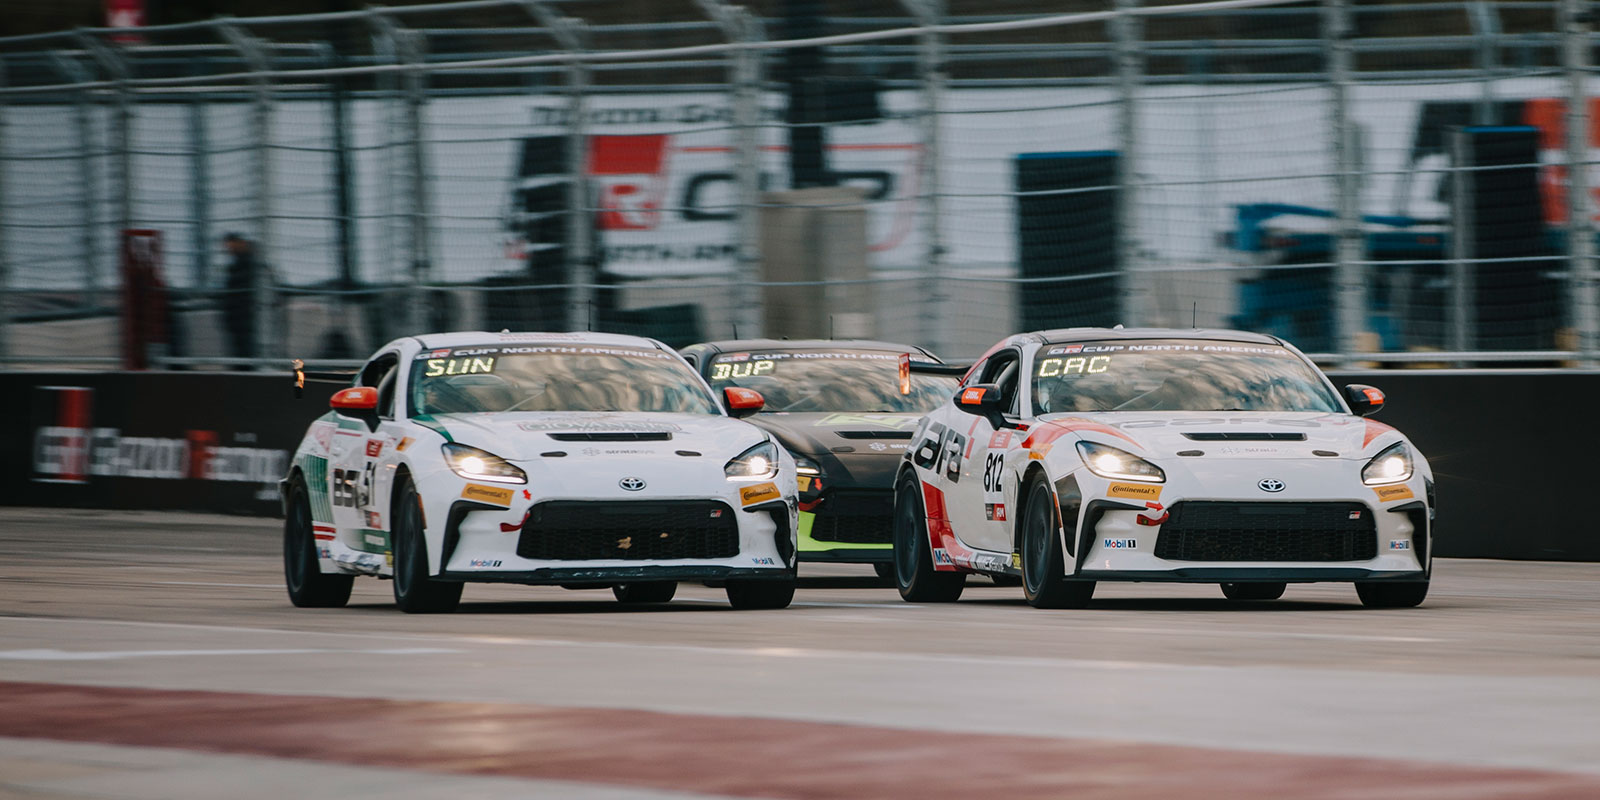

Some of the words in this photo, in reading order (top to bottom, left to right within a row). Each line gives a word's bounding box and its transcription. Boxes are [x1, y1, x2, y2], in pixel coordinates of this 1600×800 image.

[415, 349, 451, 360] GR
[454, 348, 498, 356] CUP
[581, 348, 671, 360] AMERICA
[1203, 345, 1287, 355] AMERICA
[752, 353, 791, 361] CUP
[860, 354, 937, 363] AMEICA
[425, 357, 494, 377] SUN
[711, 360, 774, 380] DUP
[1039, 355, 1111, 377] CAC
[984, 452, 1004, 492] 812
[1112, 485, 1150, 494] Continental
[1104, 539, 1127, 549] Mobil
[1127, 539, 1137, 549] 1
[470, 559, 492, 567] Mobil
